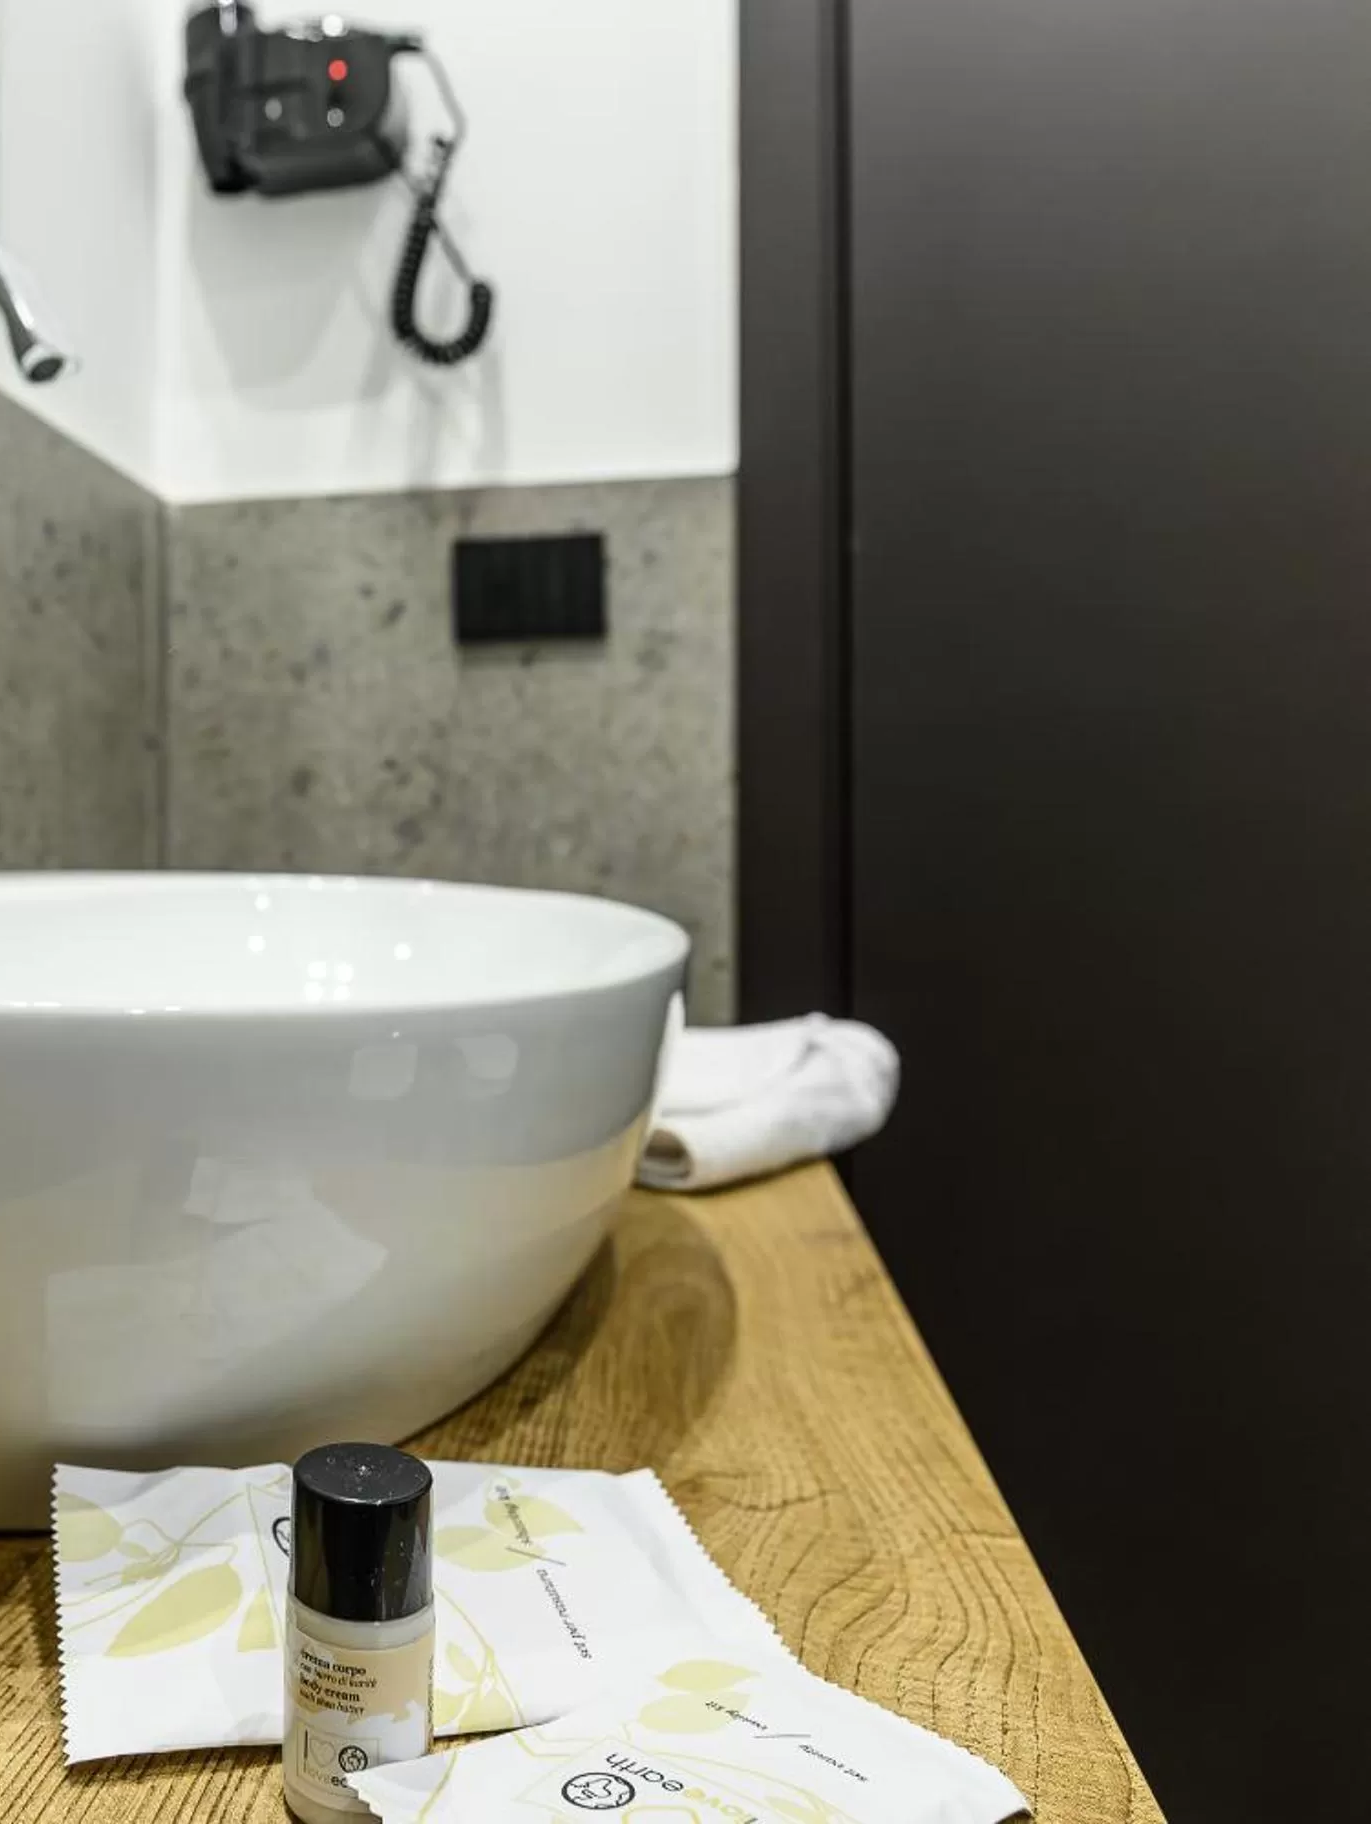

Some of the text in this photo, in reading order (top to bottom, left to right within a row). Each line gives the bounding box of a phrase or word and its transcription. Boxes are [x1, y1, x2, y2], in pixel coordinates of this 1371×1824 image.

[332, 1663, 367, 1677] corpo
[324, 1687, 360, 1703] cream
[605, 1752, 685, 1792] earth
